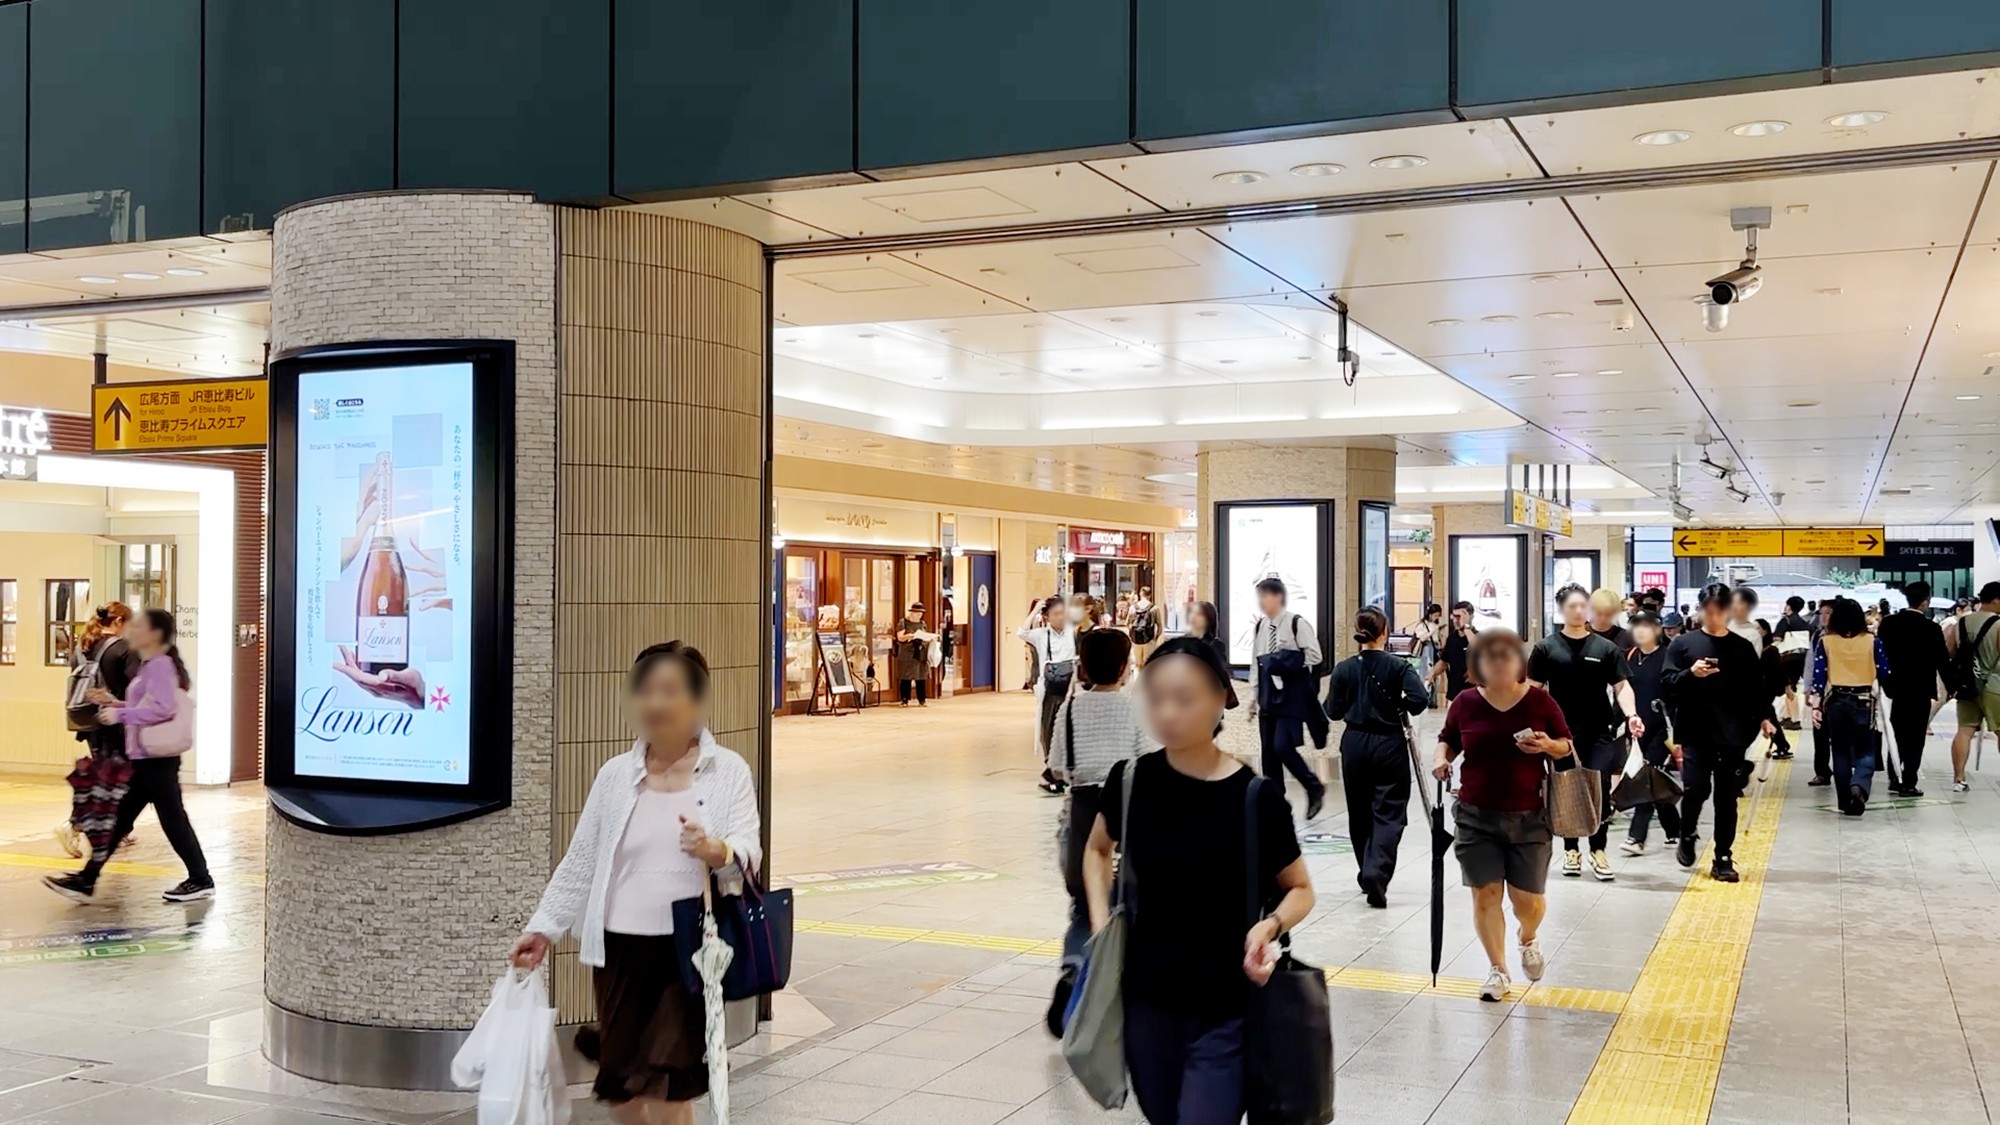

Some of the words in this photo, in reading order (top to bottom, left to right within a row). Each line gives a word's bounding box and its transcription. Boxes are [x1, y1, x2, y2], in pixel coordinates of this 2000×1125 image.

[139, 391, 180, 406] 広尾方面
[188, 387, 255, 403] JR恵比寿ビル
[188, 405, 198, 414] JR
[139, 416, 246, 434] 恵比寿プライムスクエア
[1643, 573, 1665, 585] UNI
[364, 627, 402, 649] Lanson
[298, 685, 413, 742] Lanson
